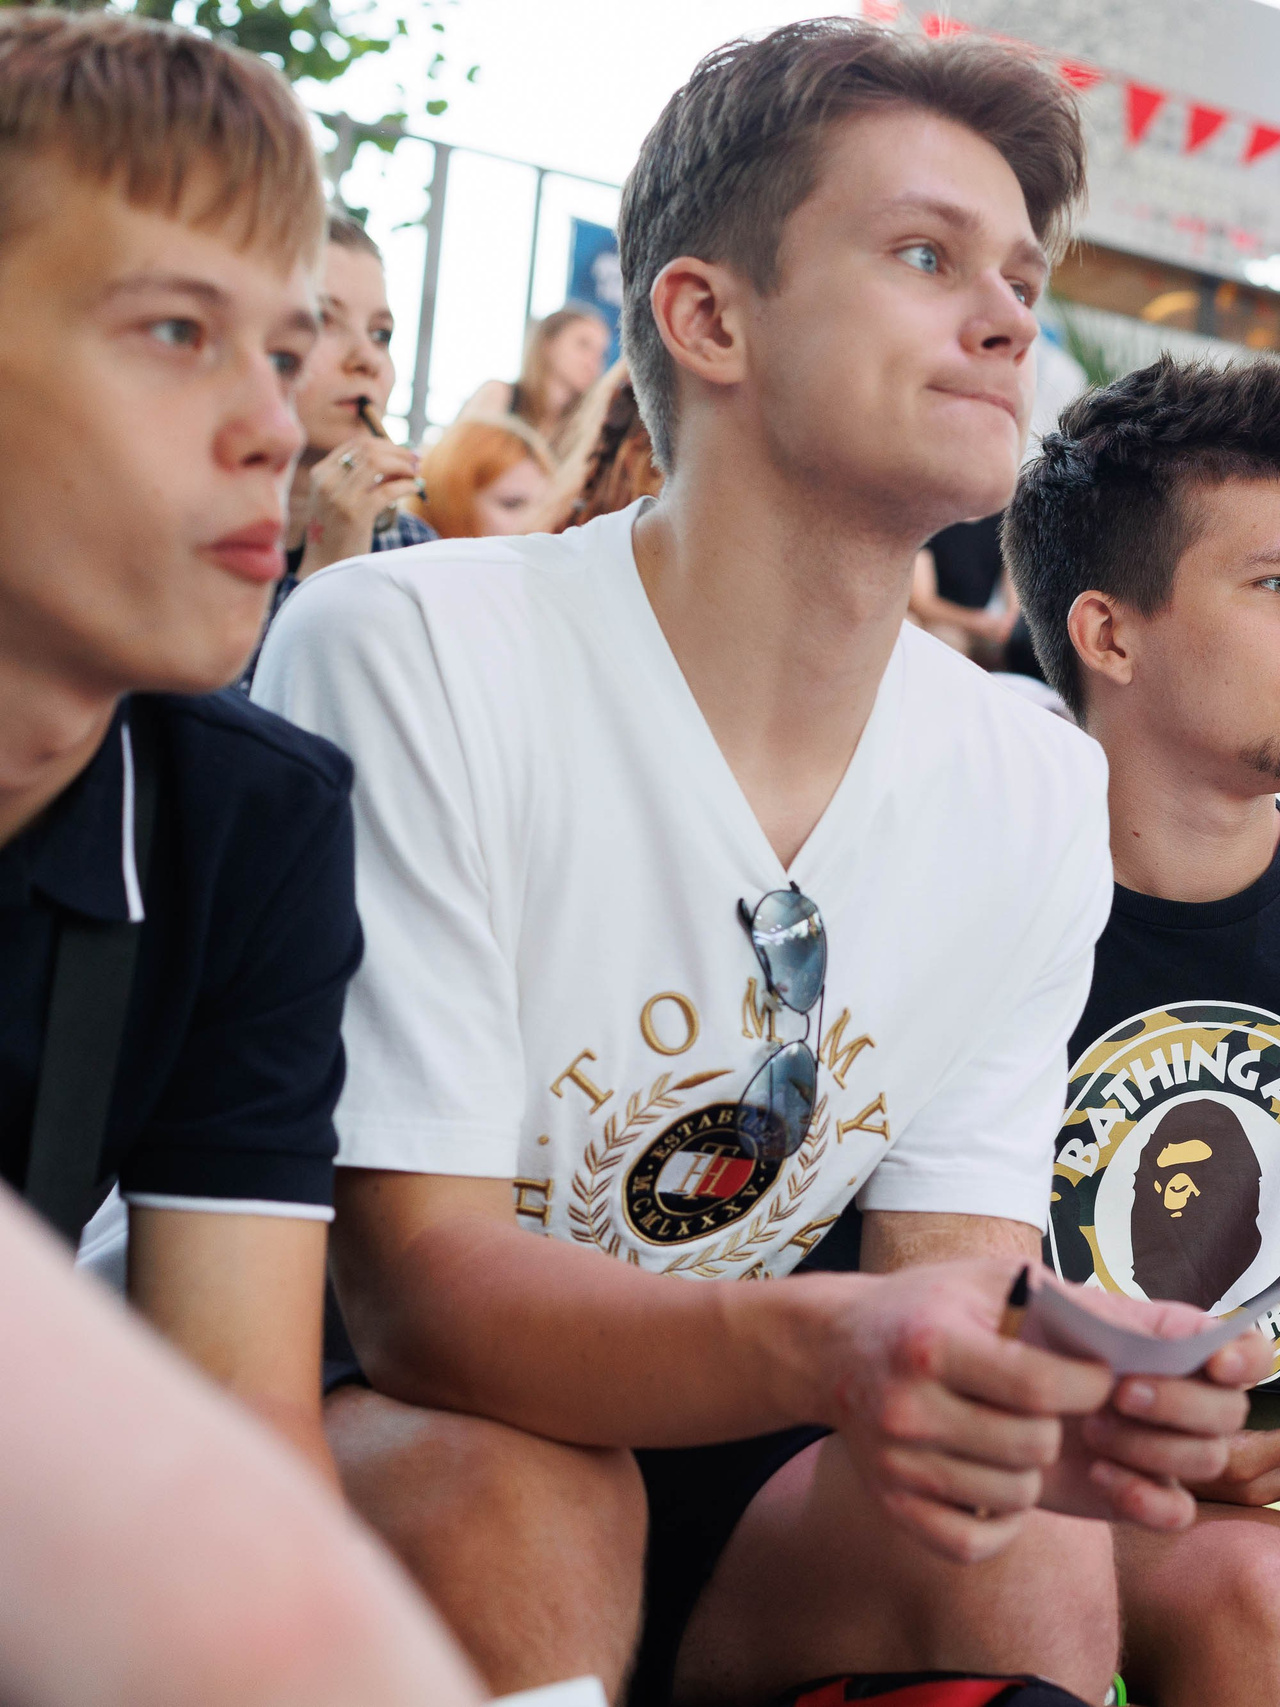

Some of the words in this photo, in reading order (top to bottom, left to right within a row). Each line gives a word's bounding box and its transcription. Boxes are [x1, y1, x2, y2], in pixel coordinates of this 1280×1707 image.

[550, 977, 890, 1144] TOMMY
[1056, 1040, 1261, 1178] BATHING
[632, 1173, 758, 1236] MCMLXXXV
